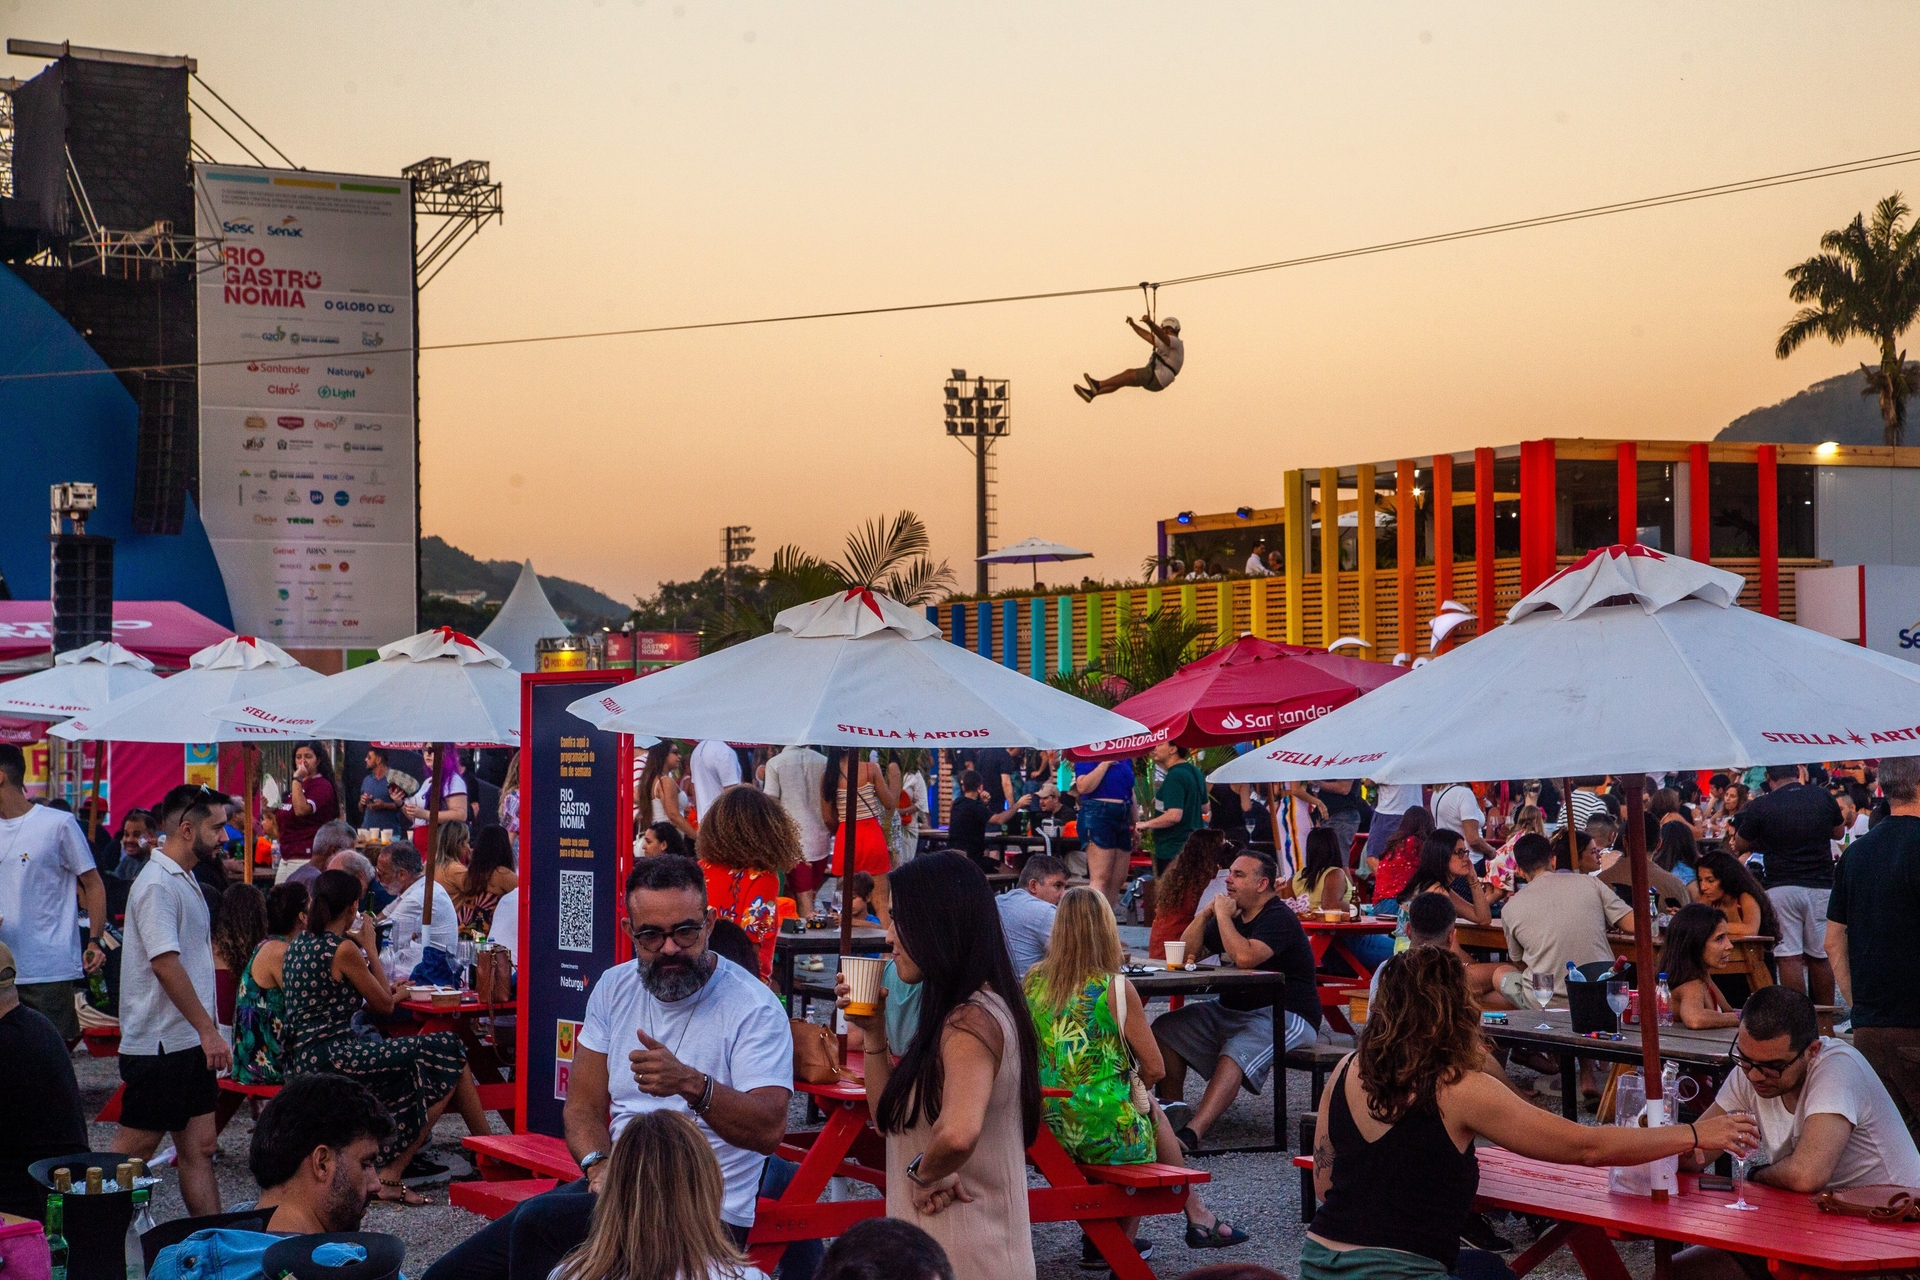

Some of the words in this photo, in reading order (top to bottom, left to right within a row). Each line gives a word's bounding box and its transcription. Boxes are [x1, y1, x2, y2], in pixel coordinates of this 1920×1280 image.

[225, 246, 265, 266] RIO
[224, 286, 306, 309] NOMIA
[325, 300, 333, 310] O
[336, 301, 375, 312] GLOBO
[260, 363, 310, 375] Santander
[327, 367, 365, 379] Naturgy
[268, 384, 295, 395] Claro
[333, 388, 355, 400] Light
[242, 706, 278, 723] STELLA
[837, 724, 902, 738] STELLA
[924, 728, 990, 739] ARTOIS
[1107, 727, 1169, 750] Santander
[1762, 732, 1848, 745] STELLA
[1266, 750, 1324, 767] STELLA
[560, 788, 574, 802] RIO
[560, 802, 590, 816] GASTRO
[560, 815, 586, 829] NOMIA
[560, 976, 584, 991] Naturgy
